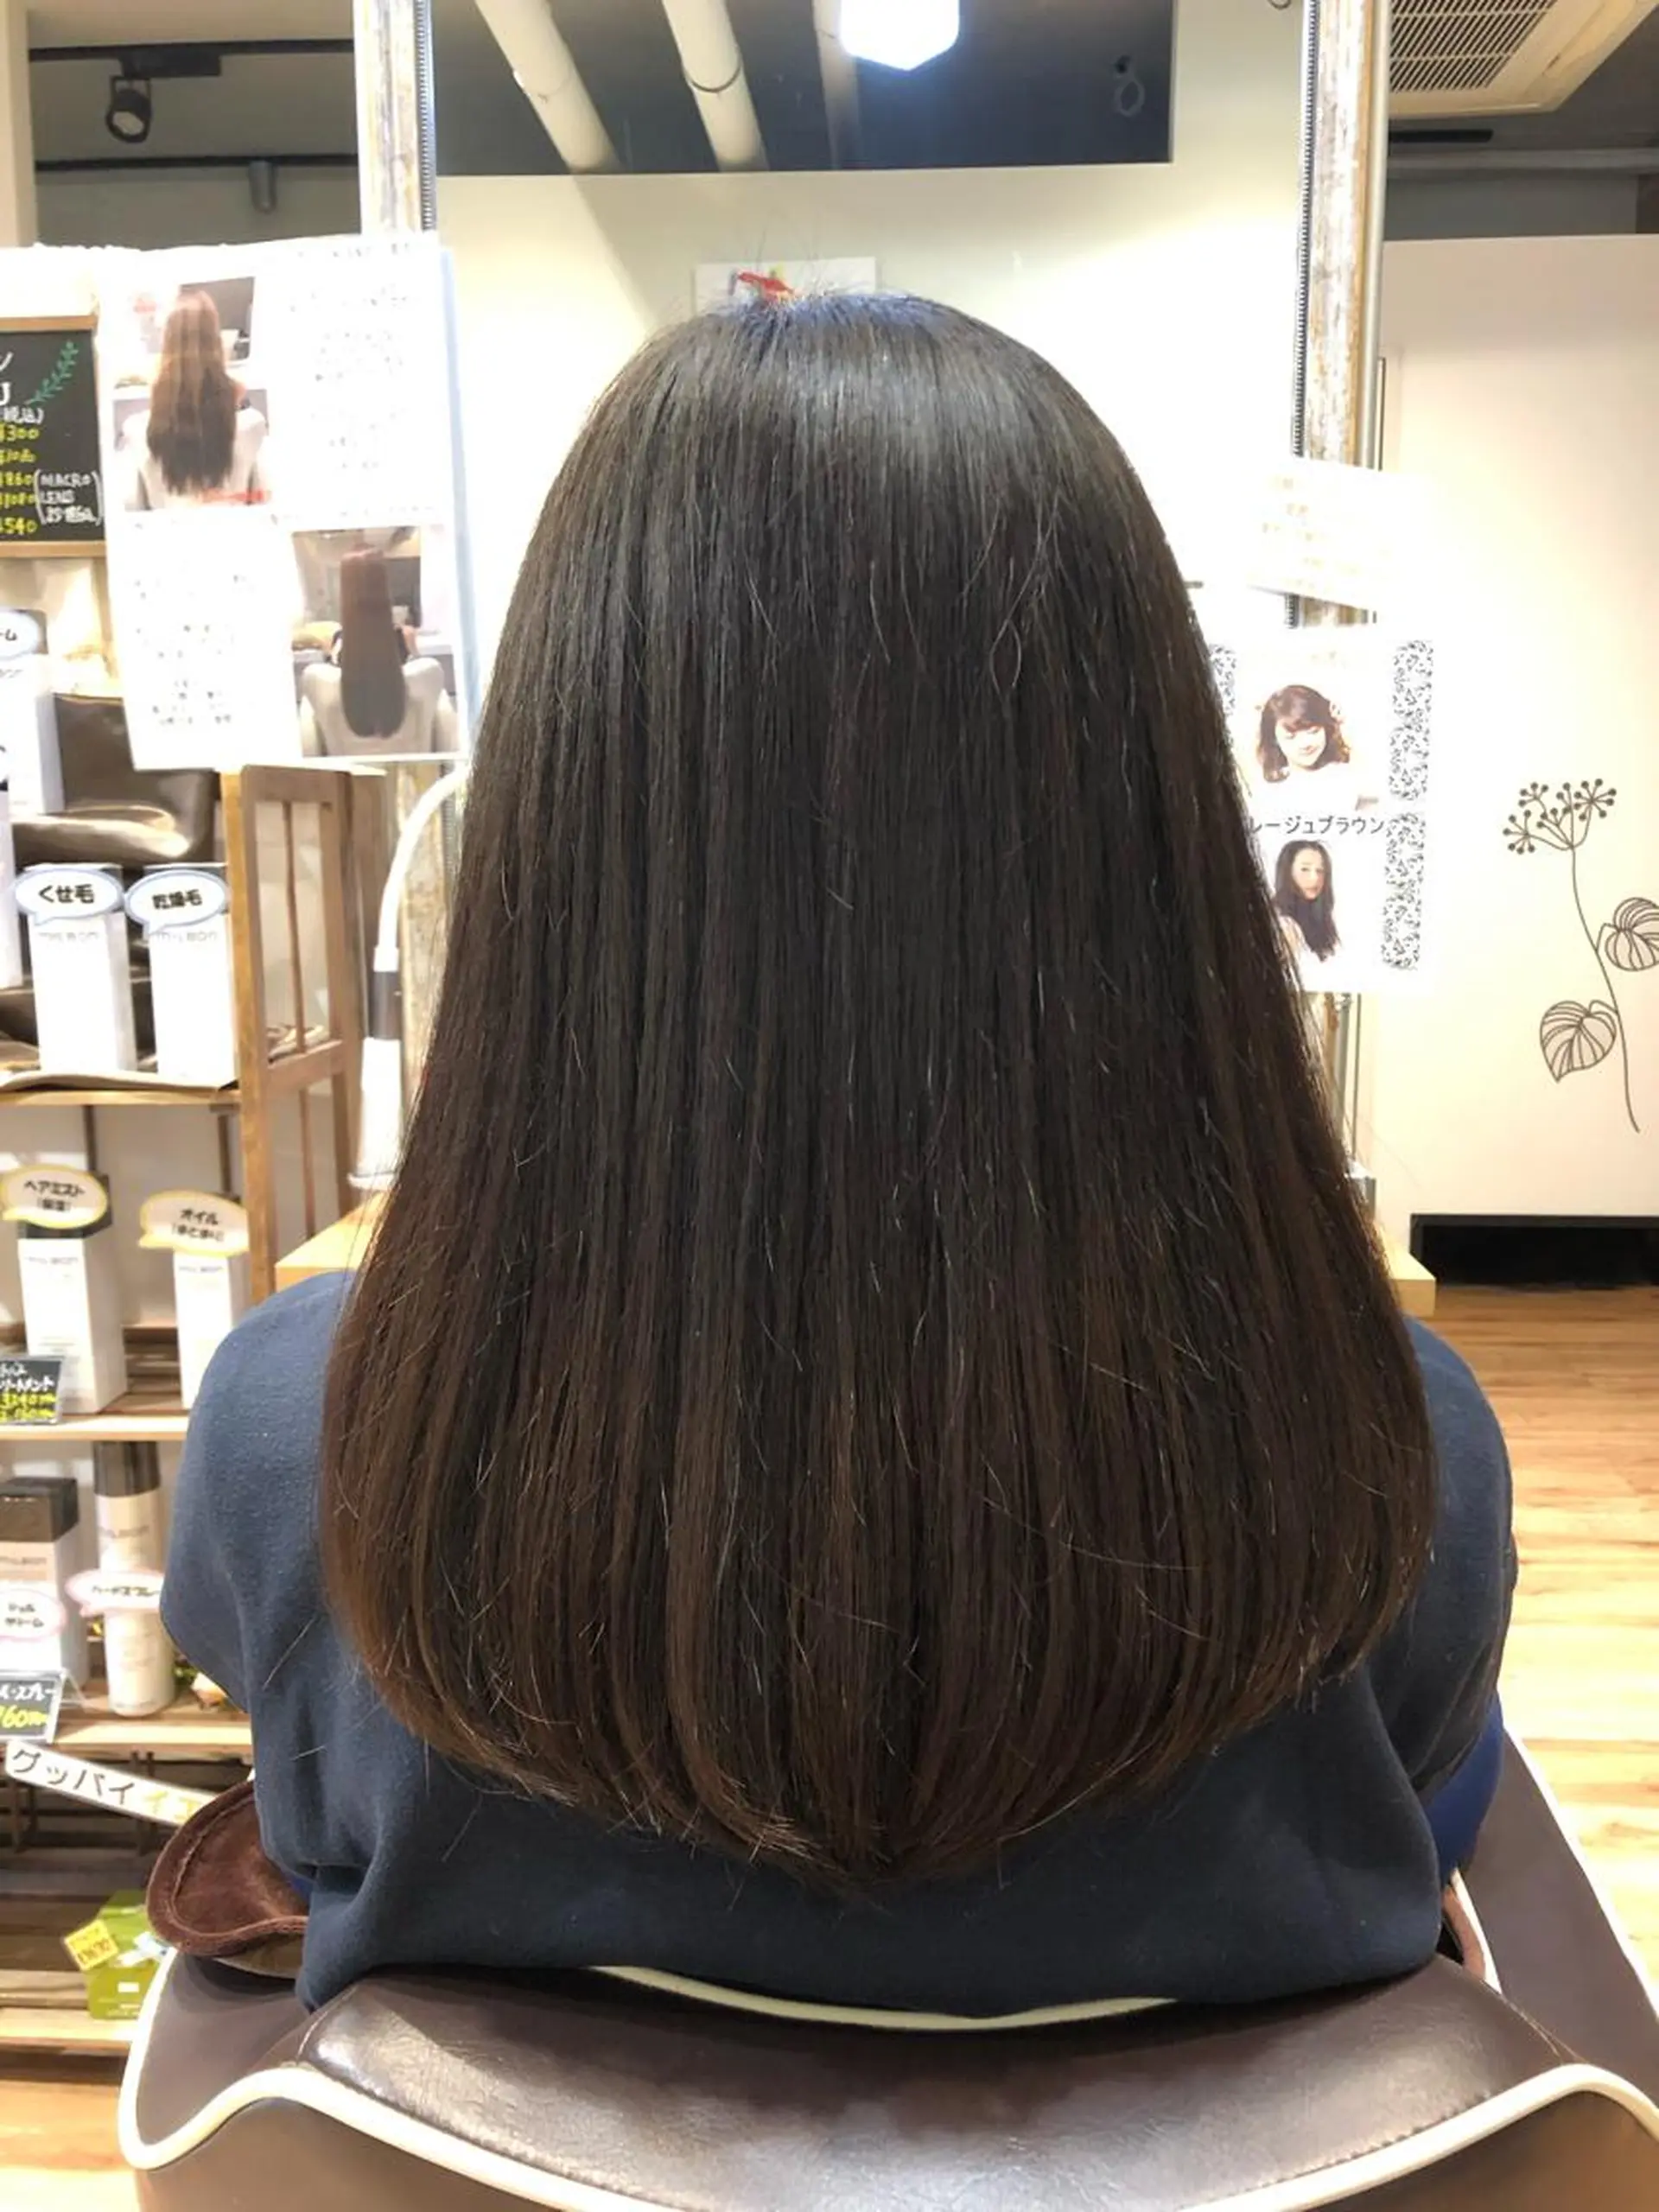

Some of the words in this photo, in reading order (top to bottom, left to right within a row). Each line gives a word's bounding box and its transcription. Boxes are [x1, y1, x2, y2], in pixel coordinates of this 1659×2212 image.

[38, 884, 94, 904] くせ毛
[13, 1749, 135, 1805] グッバイ
